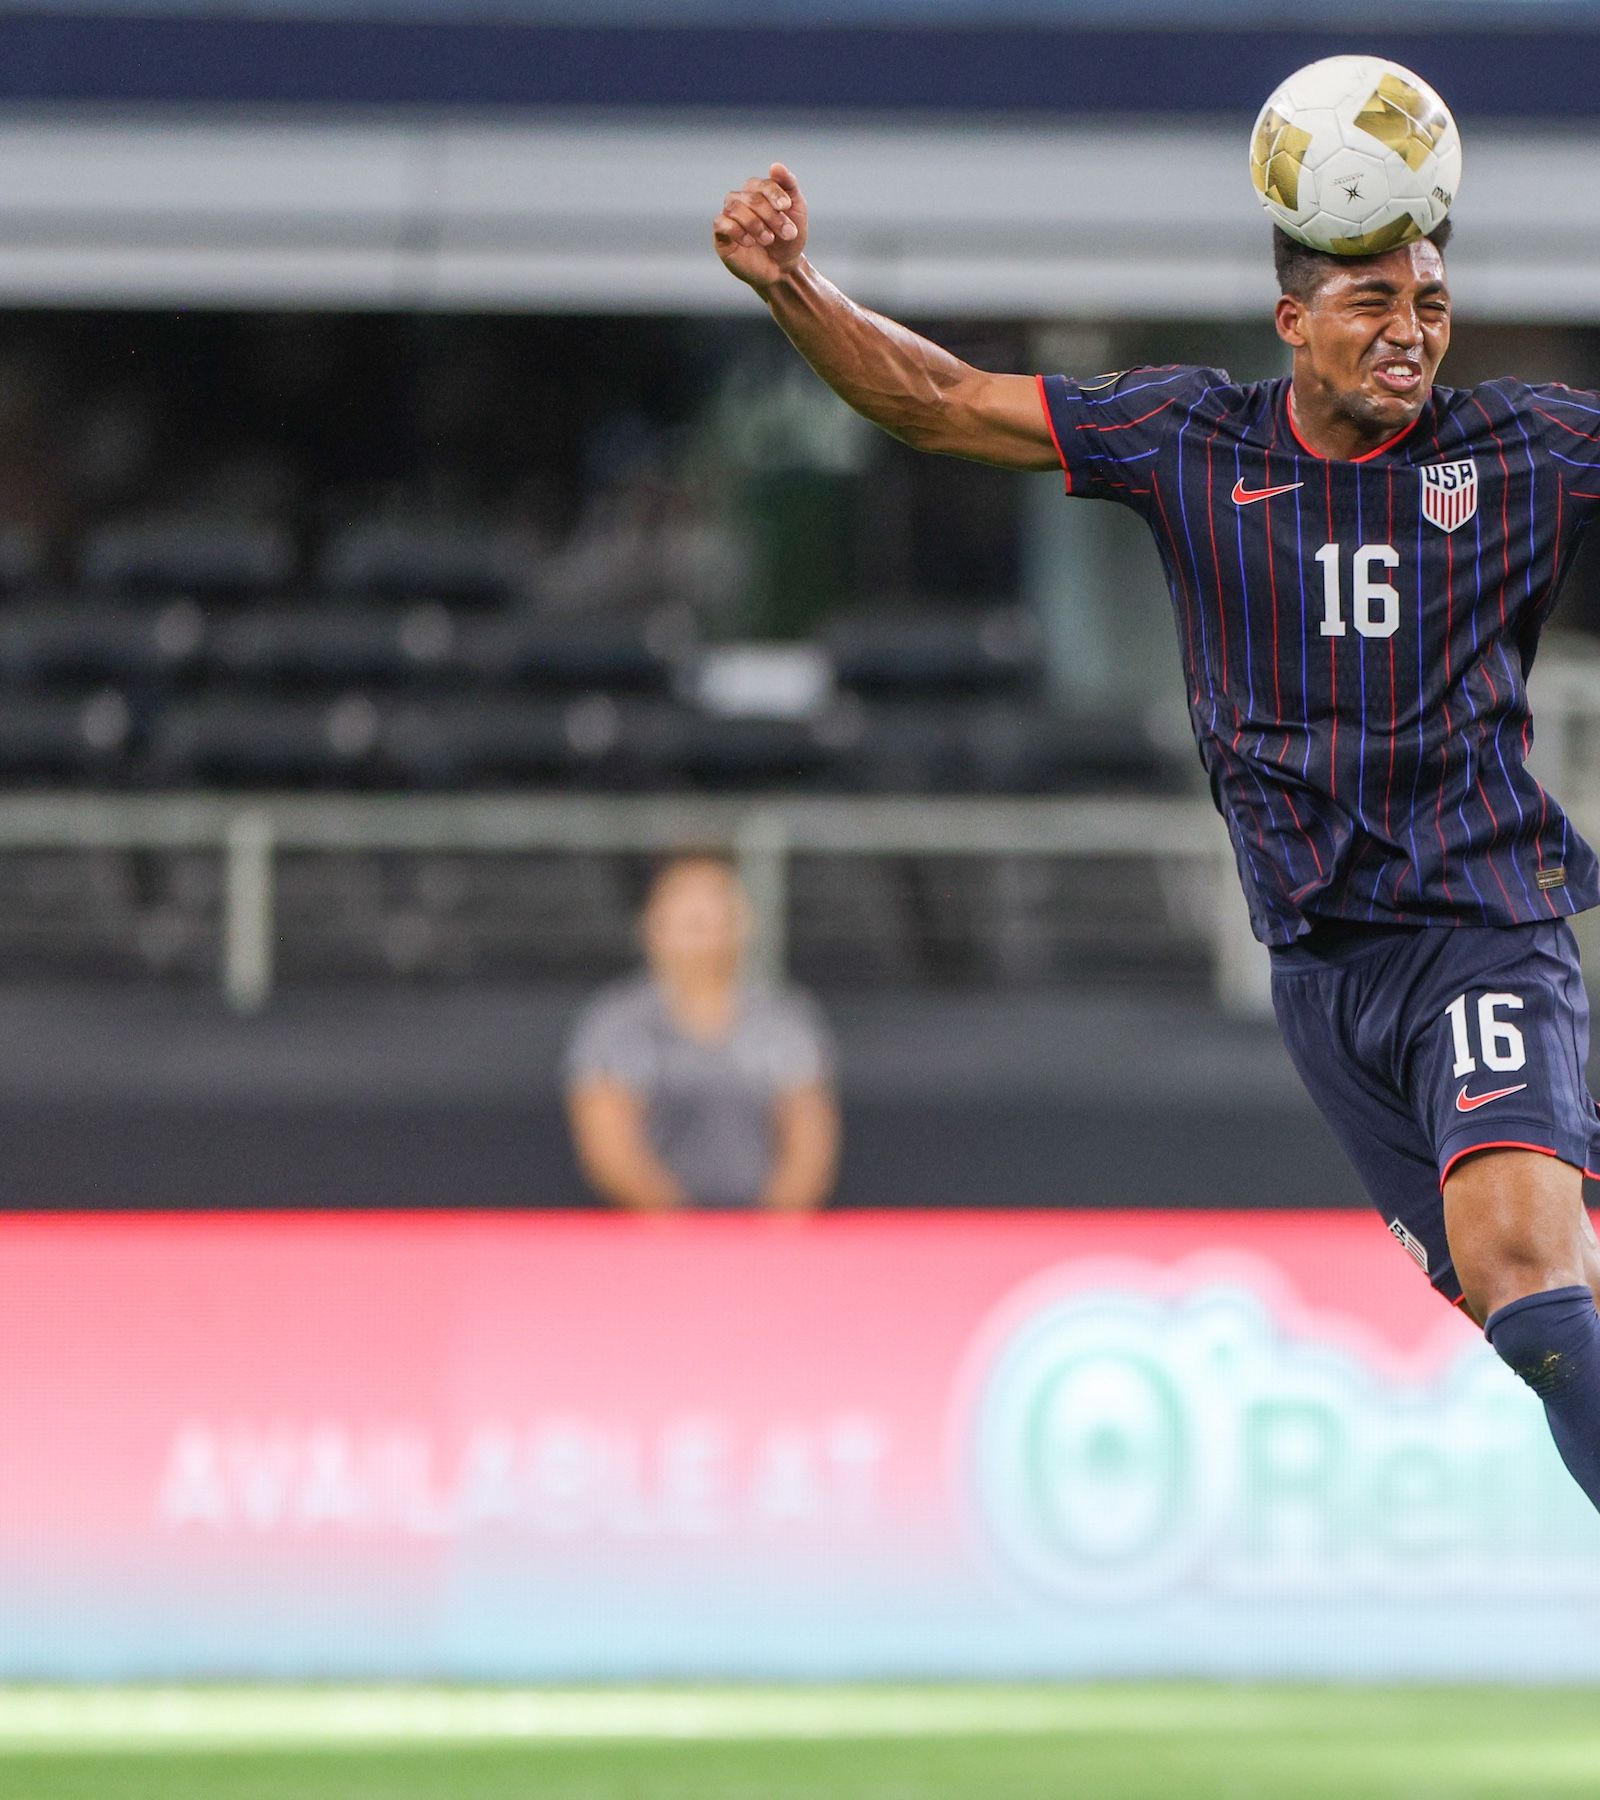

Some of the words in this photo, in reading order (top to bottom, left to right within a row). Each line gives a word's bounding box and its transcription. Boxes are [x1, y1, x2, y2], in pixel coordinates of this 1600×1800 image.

[1425, 463, 1474, 490] USA
[1314, 543, 1400, 638] 16
[1444, 992, 1527, 1079] 16
[158, 1420, 730, 1534] AVAILABLE
[752, 1415, 888, 1534] AT
